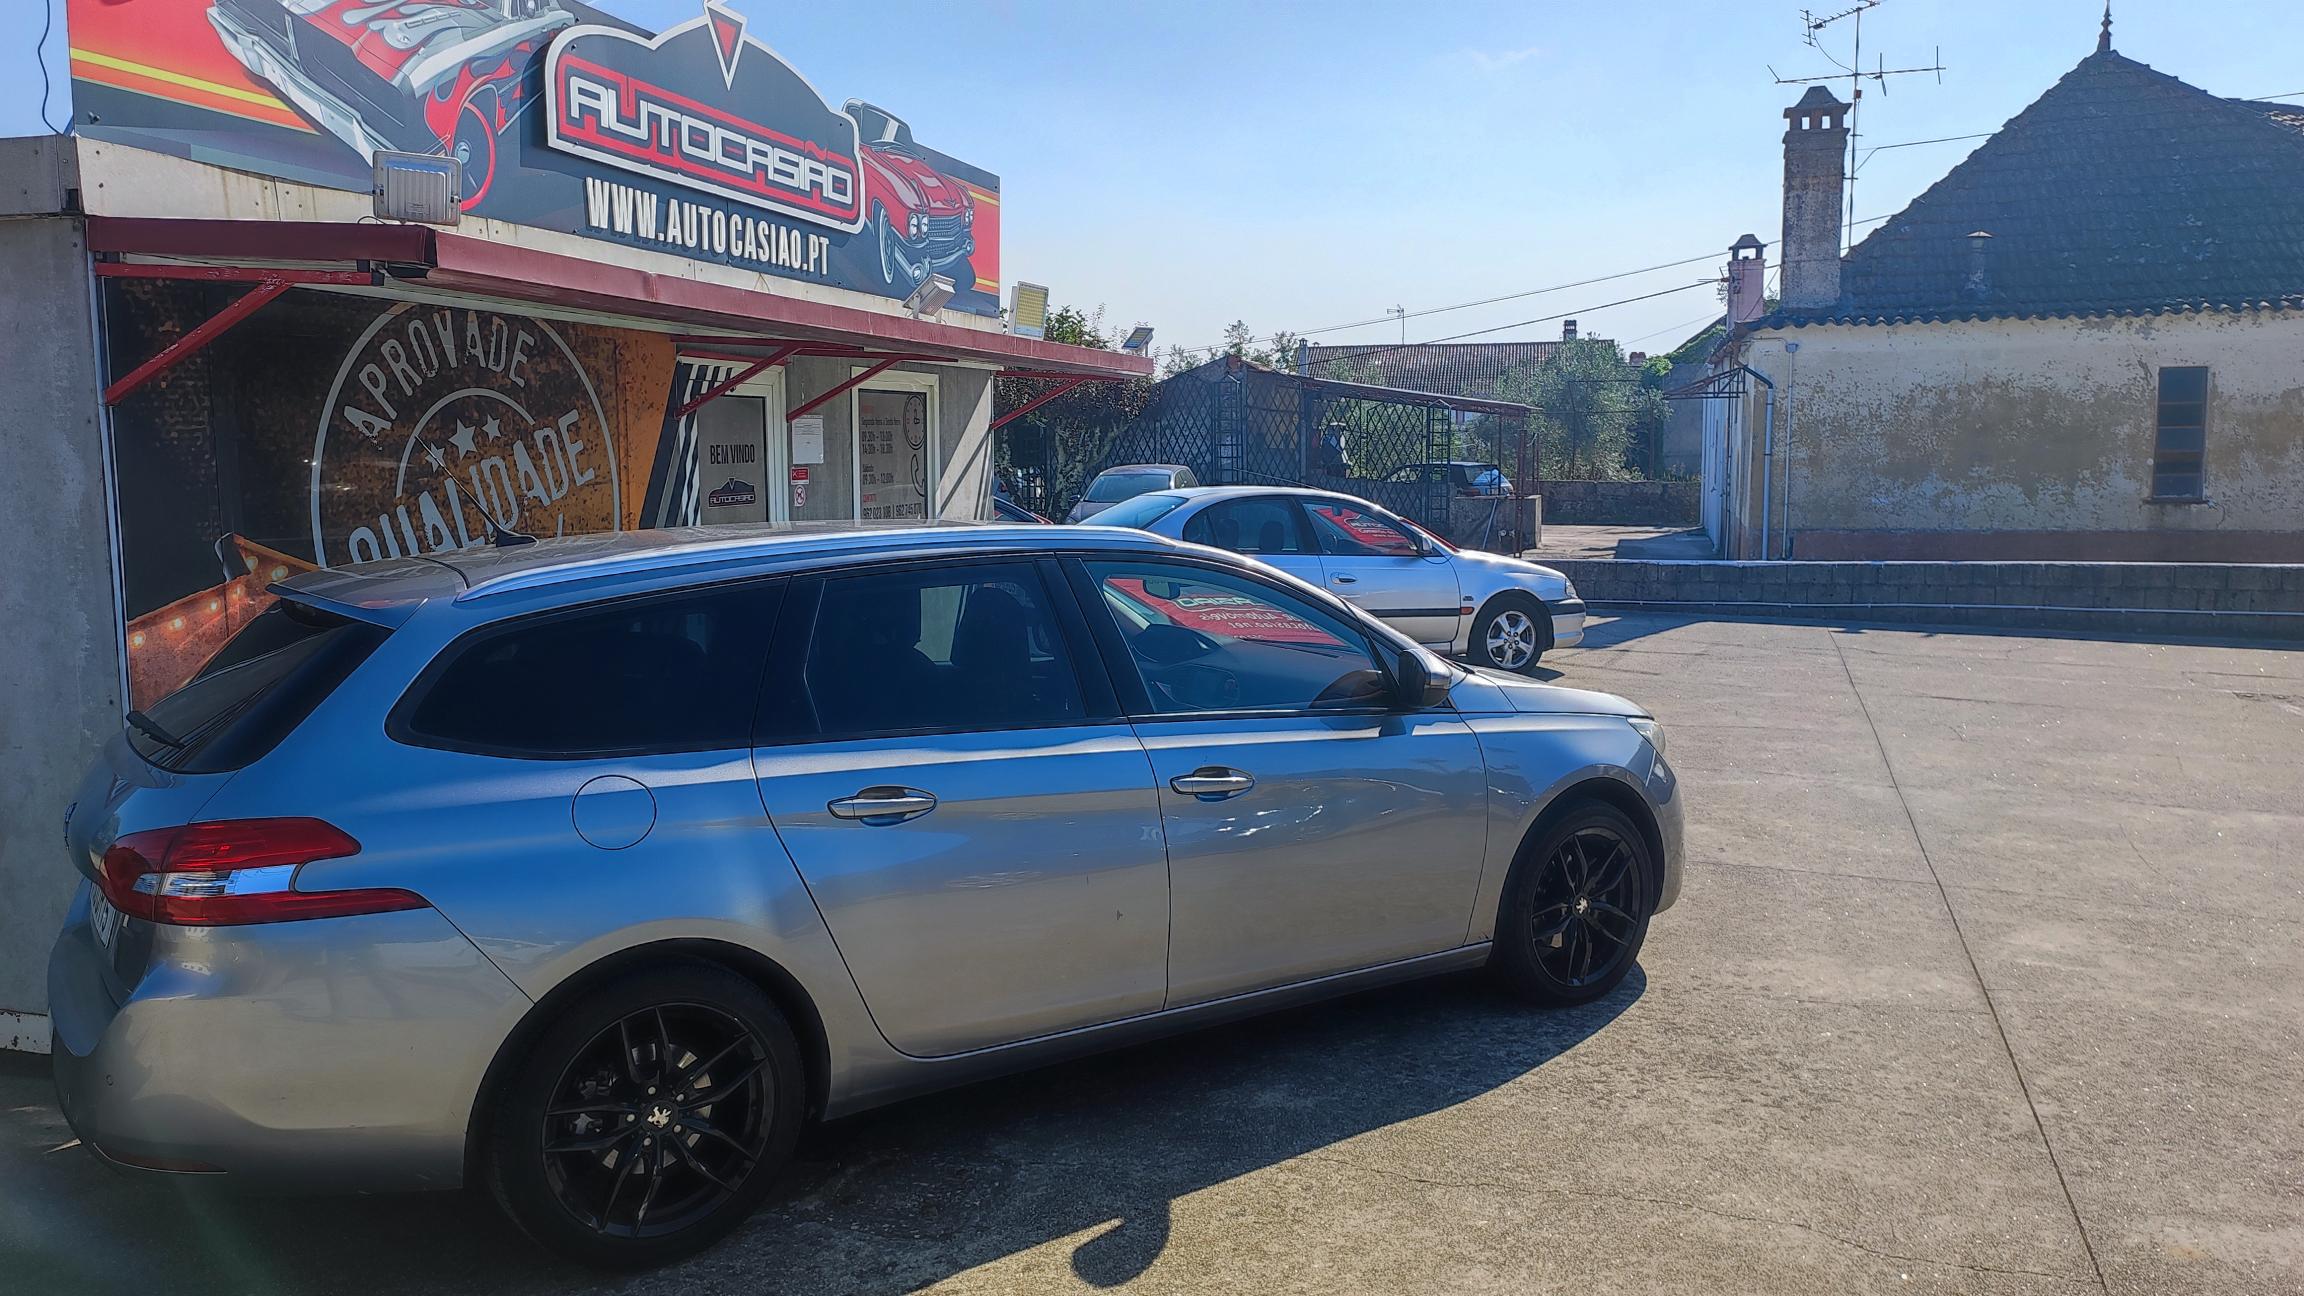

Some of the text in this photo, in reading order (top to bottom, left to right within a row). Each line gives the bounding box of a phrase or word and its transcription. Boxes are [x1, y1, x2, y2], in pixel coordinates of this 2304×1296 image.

[586, 176, 830, 275] WWW.AUTOCASIAO.PT
[710, 444, 755, 464] BEM VINDO
